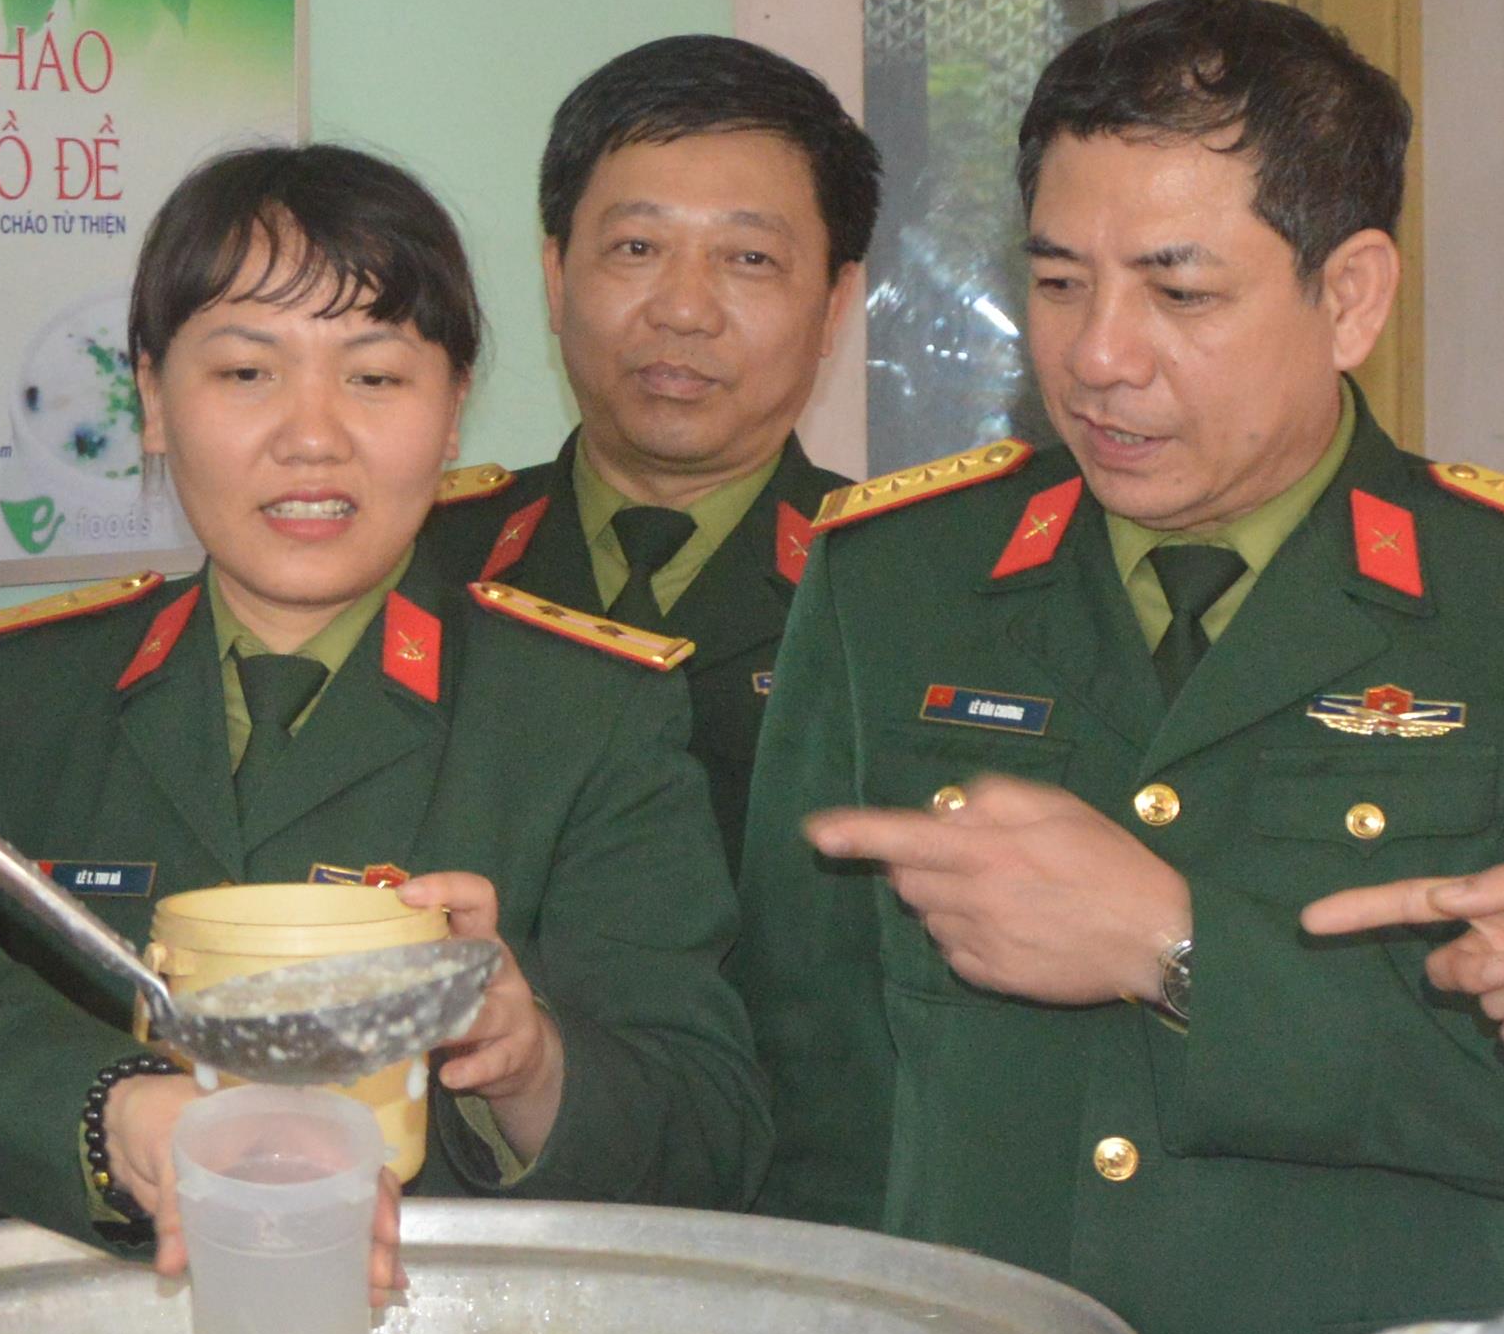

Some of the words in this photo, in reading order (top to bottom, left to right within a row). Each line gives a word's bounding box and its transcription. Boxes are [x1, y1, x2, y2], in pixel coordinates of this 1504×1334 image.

[53, 113, 124, 201] ĐỀ
[0, 209, 48, 235] CHÁO
[79, 212, 127, 239] THIỆN
